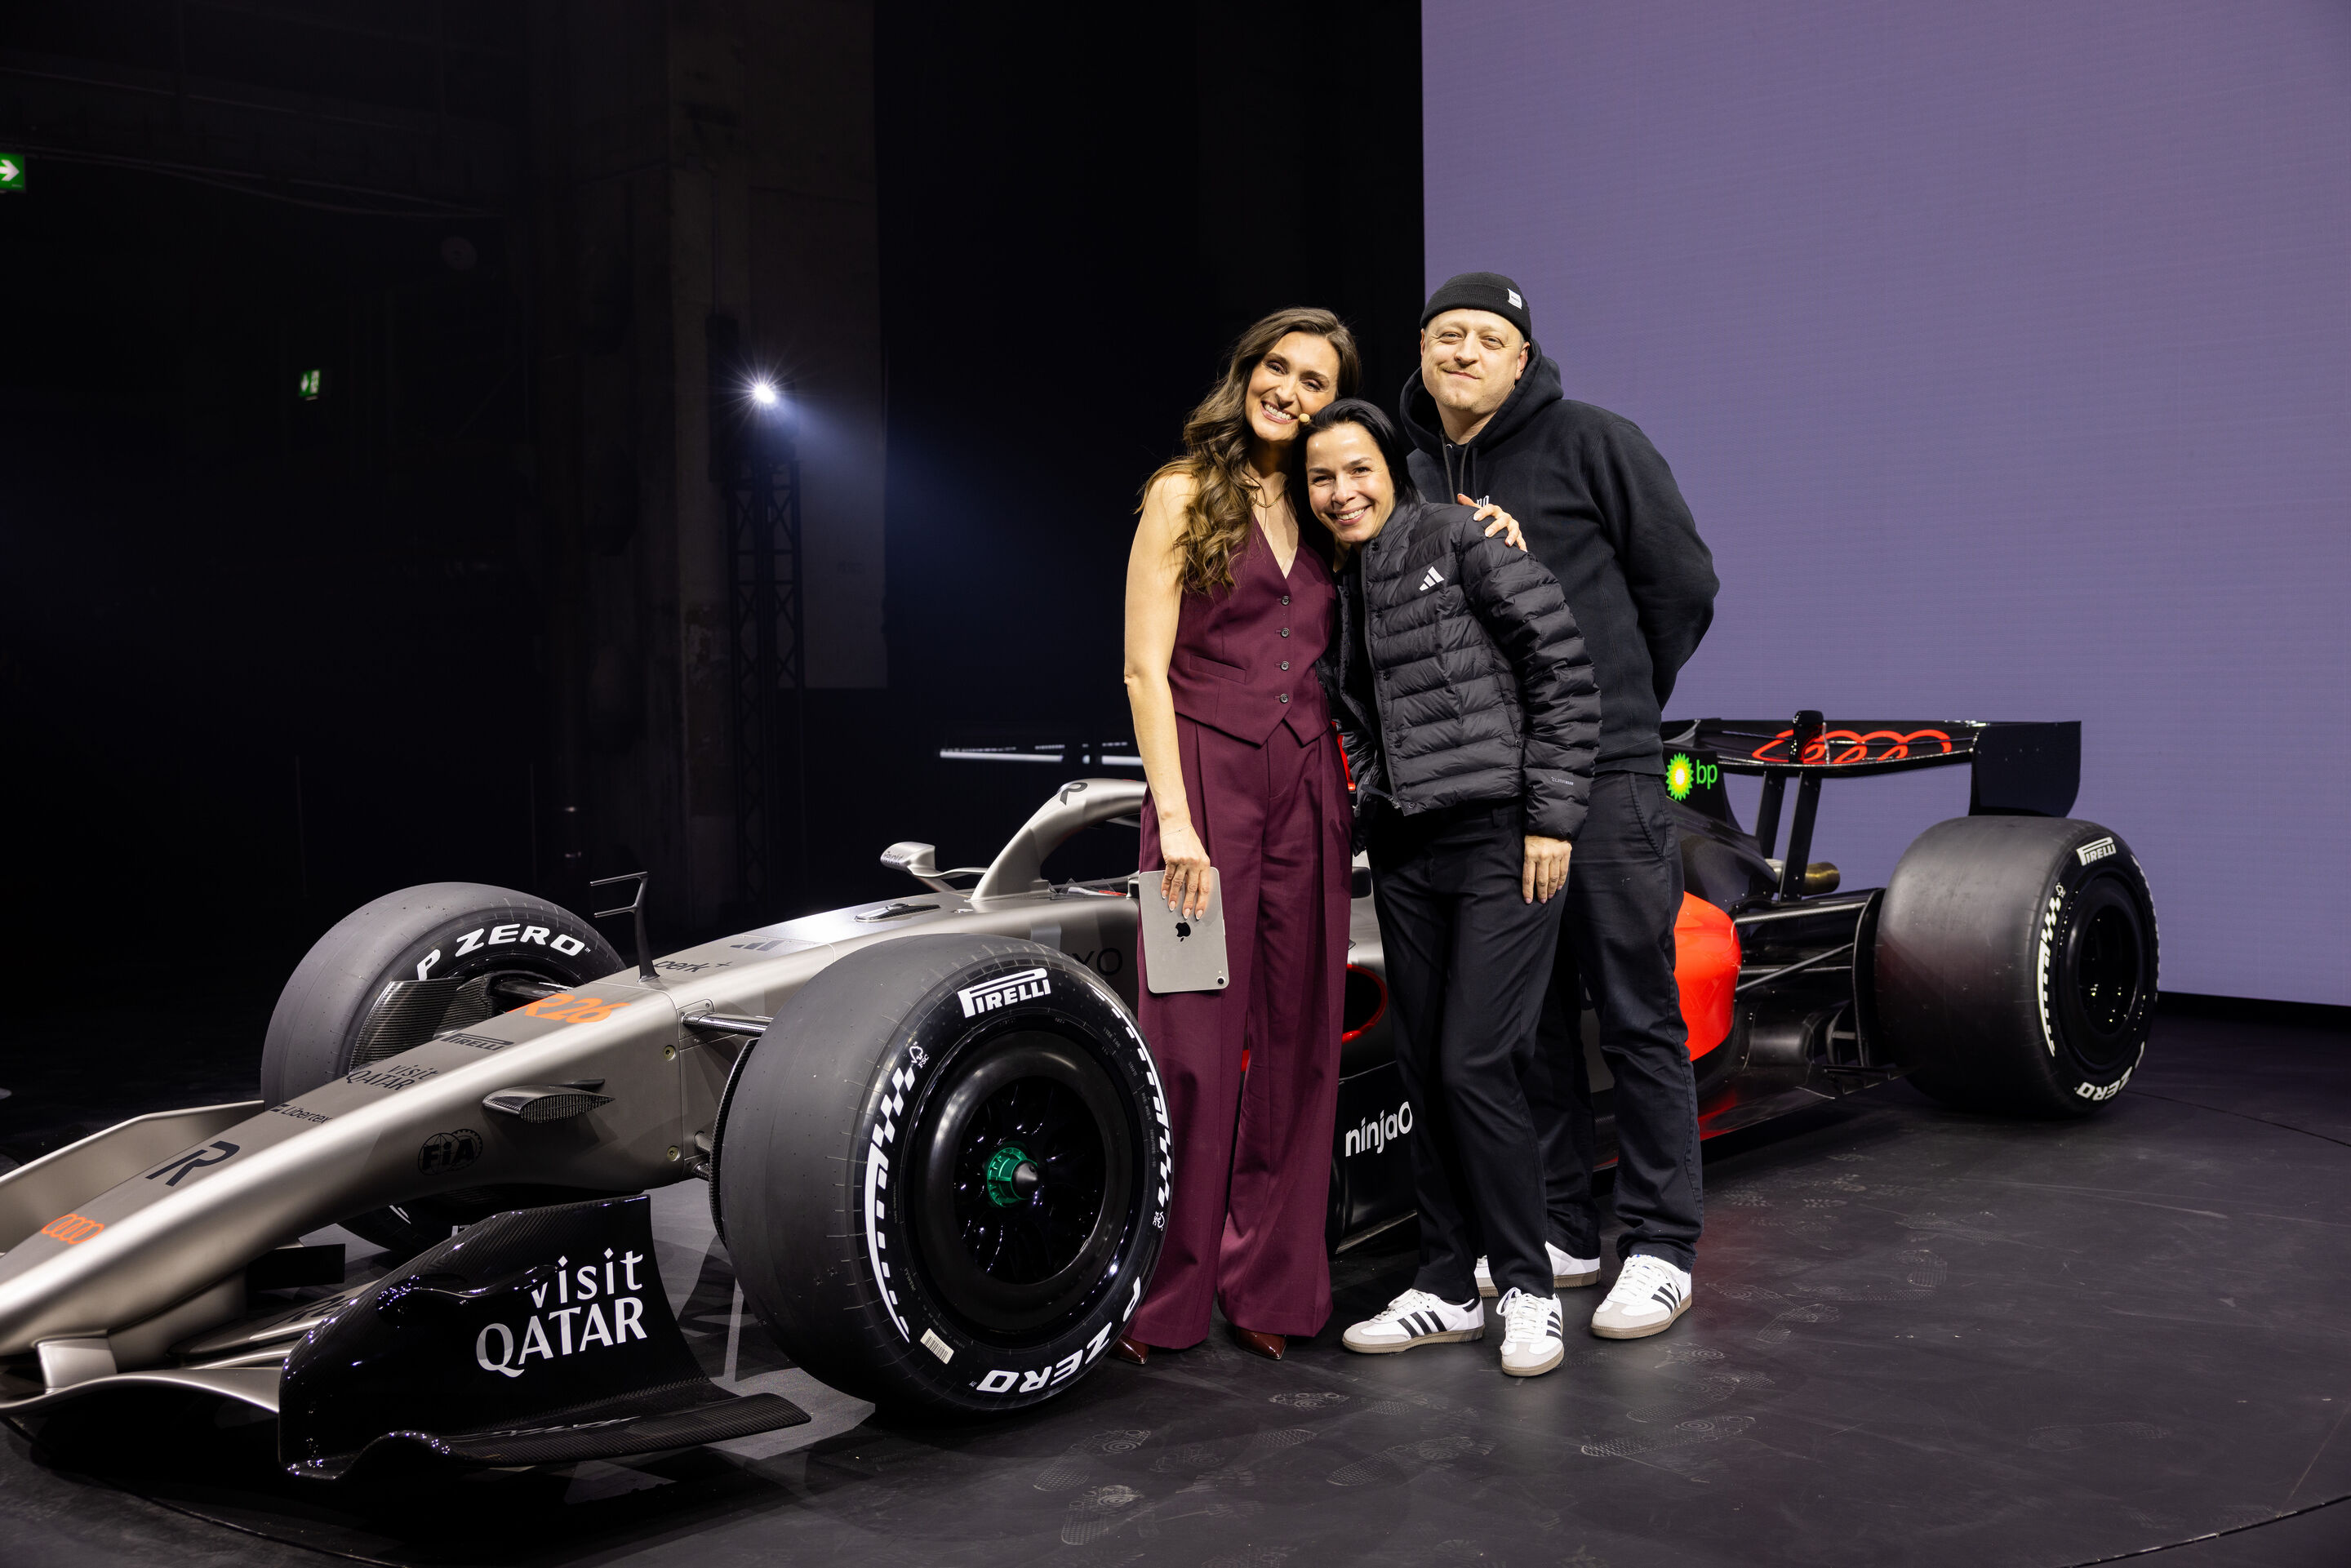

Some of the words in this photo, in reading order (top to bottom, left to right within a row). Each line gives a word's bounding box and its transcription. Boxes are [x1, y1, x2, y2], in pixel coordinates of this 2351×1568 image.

[1695, 759, 1718, 790] bp
[2076, 837, 2117, 866] PIRELLI
[416, 948, 441, 980] P
[455, 923, 585, 957] ZERO
[957, 967, 1051, 1018] PIRELLI
[504, 993, 632, 1024] R26
[440, 1033, 515, 1051] PIRELLI
[345, 1070, 416, 1090] QATAR
[387, 1064, 439, 1080] visit
[2076, 1066, 2133, 1101] ZERO
[282, 1105, 334, 1124] Libertex
[531, 1247, 644, 1309] visit
[476, 1296, 648, 1378] QATAR
[976, 1321, 1113, 1393] ZERO
